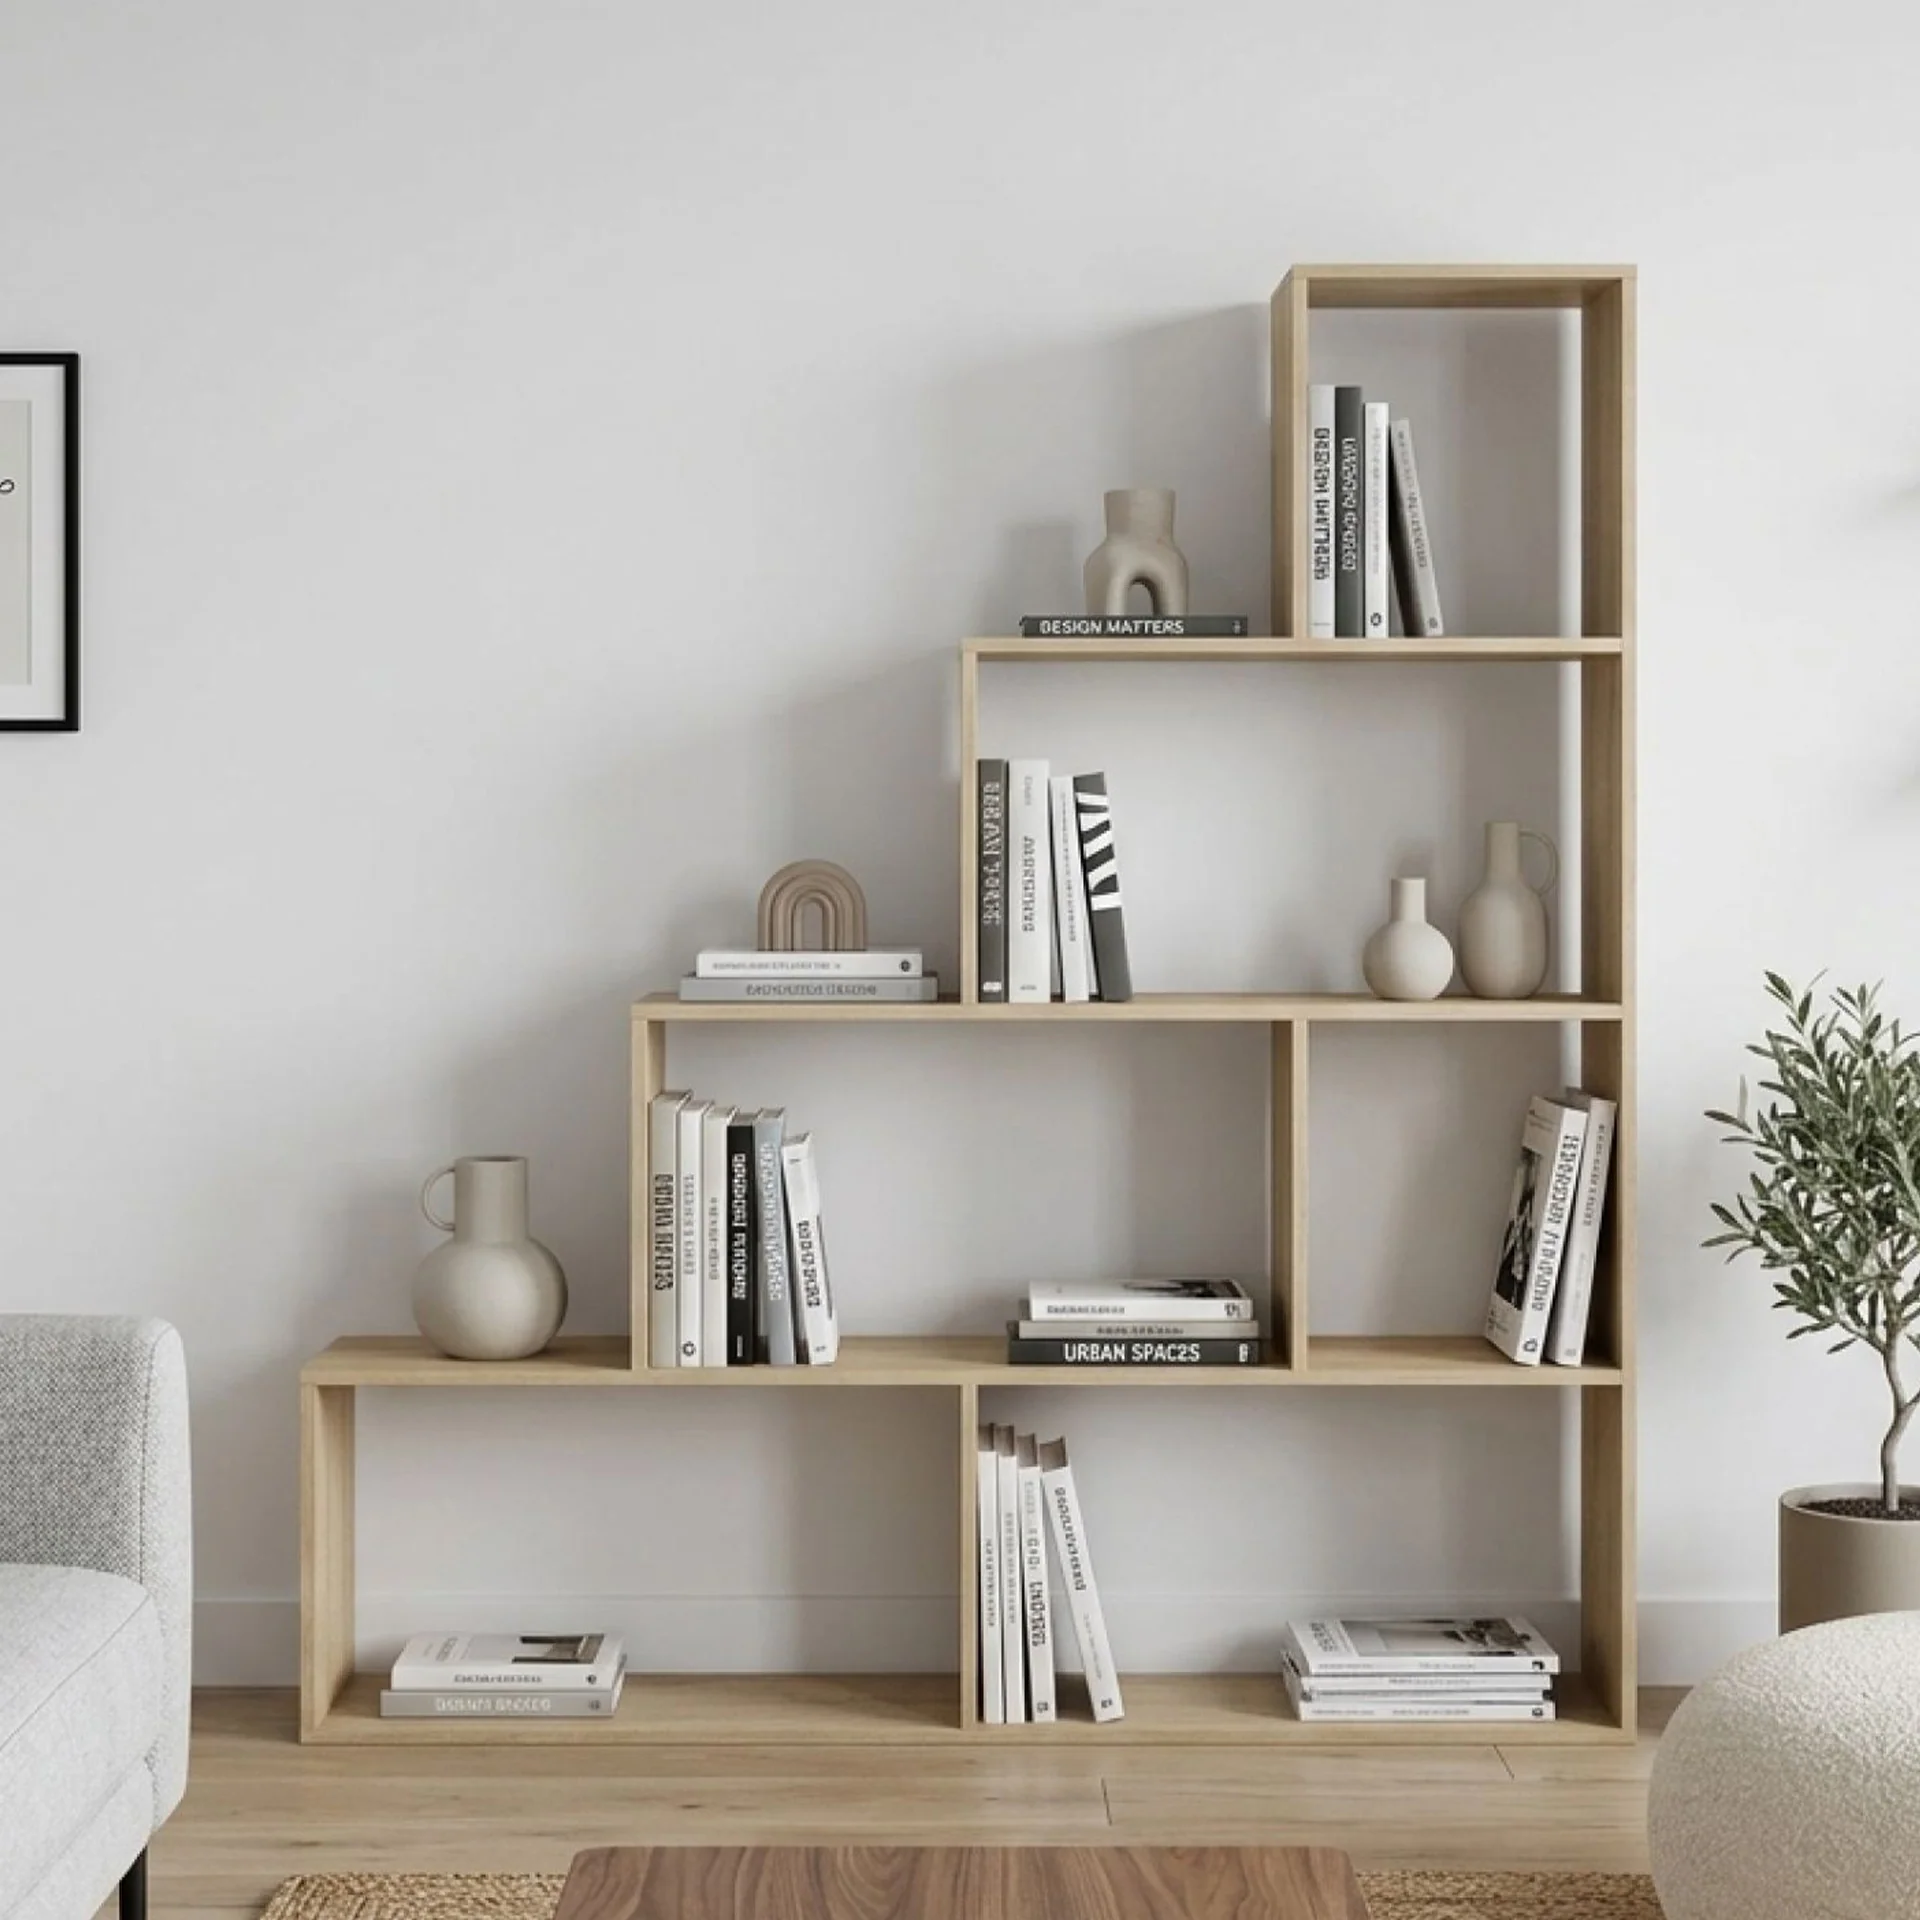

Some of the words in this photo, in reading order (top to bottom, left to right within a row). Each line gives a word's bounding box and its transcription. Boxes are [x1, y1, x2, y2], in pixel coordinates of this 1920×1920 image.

[1040, 619, 1102, 634] DESIGN
[1106, 619, 1184, 634] MATTERS
[1064, 1343, 1126, 1363] URBAN
